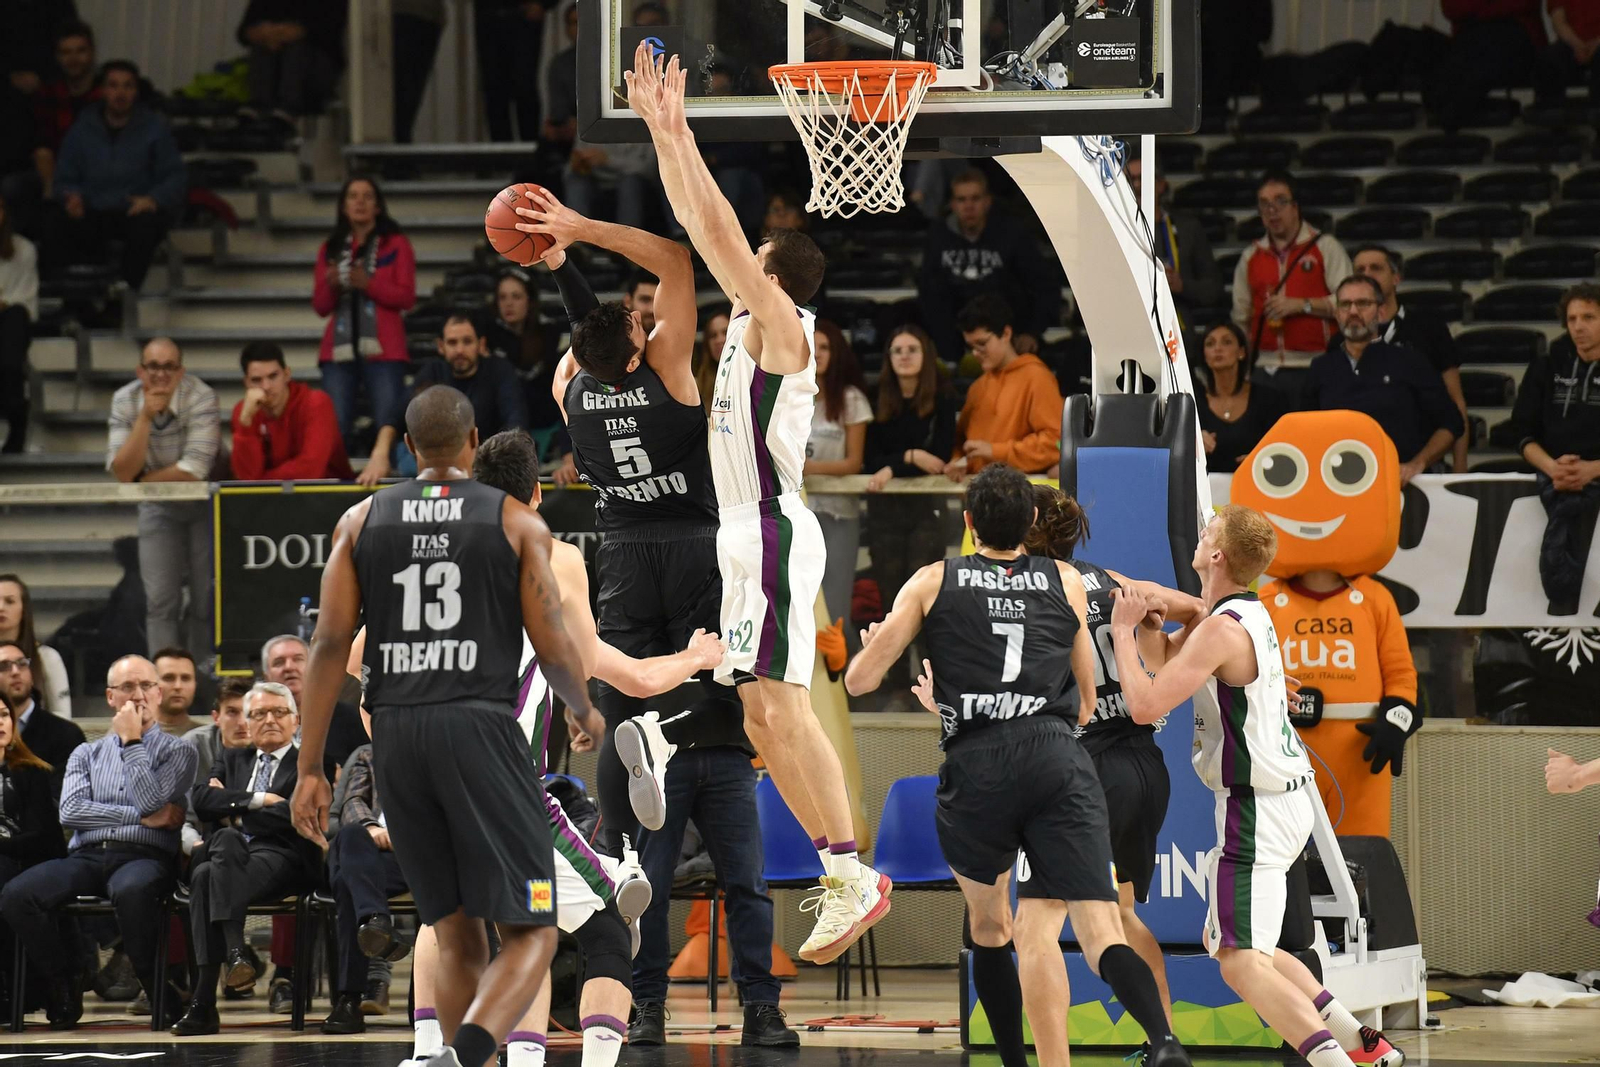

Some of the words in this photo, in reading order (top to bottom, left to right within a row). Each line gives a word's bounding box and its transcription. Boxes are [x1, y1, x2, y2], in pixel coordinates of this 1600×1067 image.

[1093, 47, 1136, 55] oneteam
[582, 386, 650, 411] GENTILE
[604, 416, 638, 431] ITAS
[608, 427, 640, 437] MUTUA
[610, 437, 653, 480] 5
[402, 498, 465, 523] KNOX
[412, 533, 450, 550] ITAS
[411, 549, 449, 559] MUTUA
[957, 568, 1049, 592] PASCOLO
[392, 561, 462, 631] 13
[987, 596, 1026, 612] ITAS
[988, 609, 1026, 619] MUTUA
[1294, 617, 1354, 635] casa
[379, 639, 478, 675] TRENTO
[991, 622, 1025, 683] 7
[1282, 635, 1356, 670] tua
[1319, 671, 1356, 681] ITALIANO
[1300, 694, 1315, 702] asa
